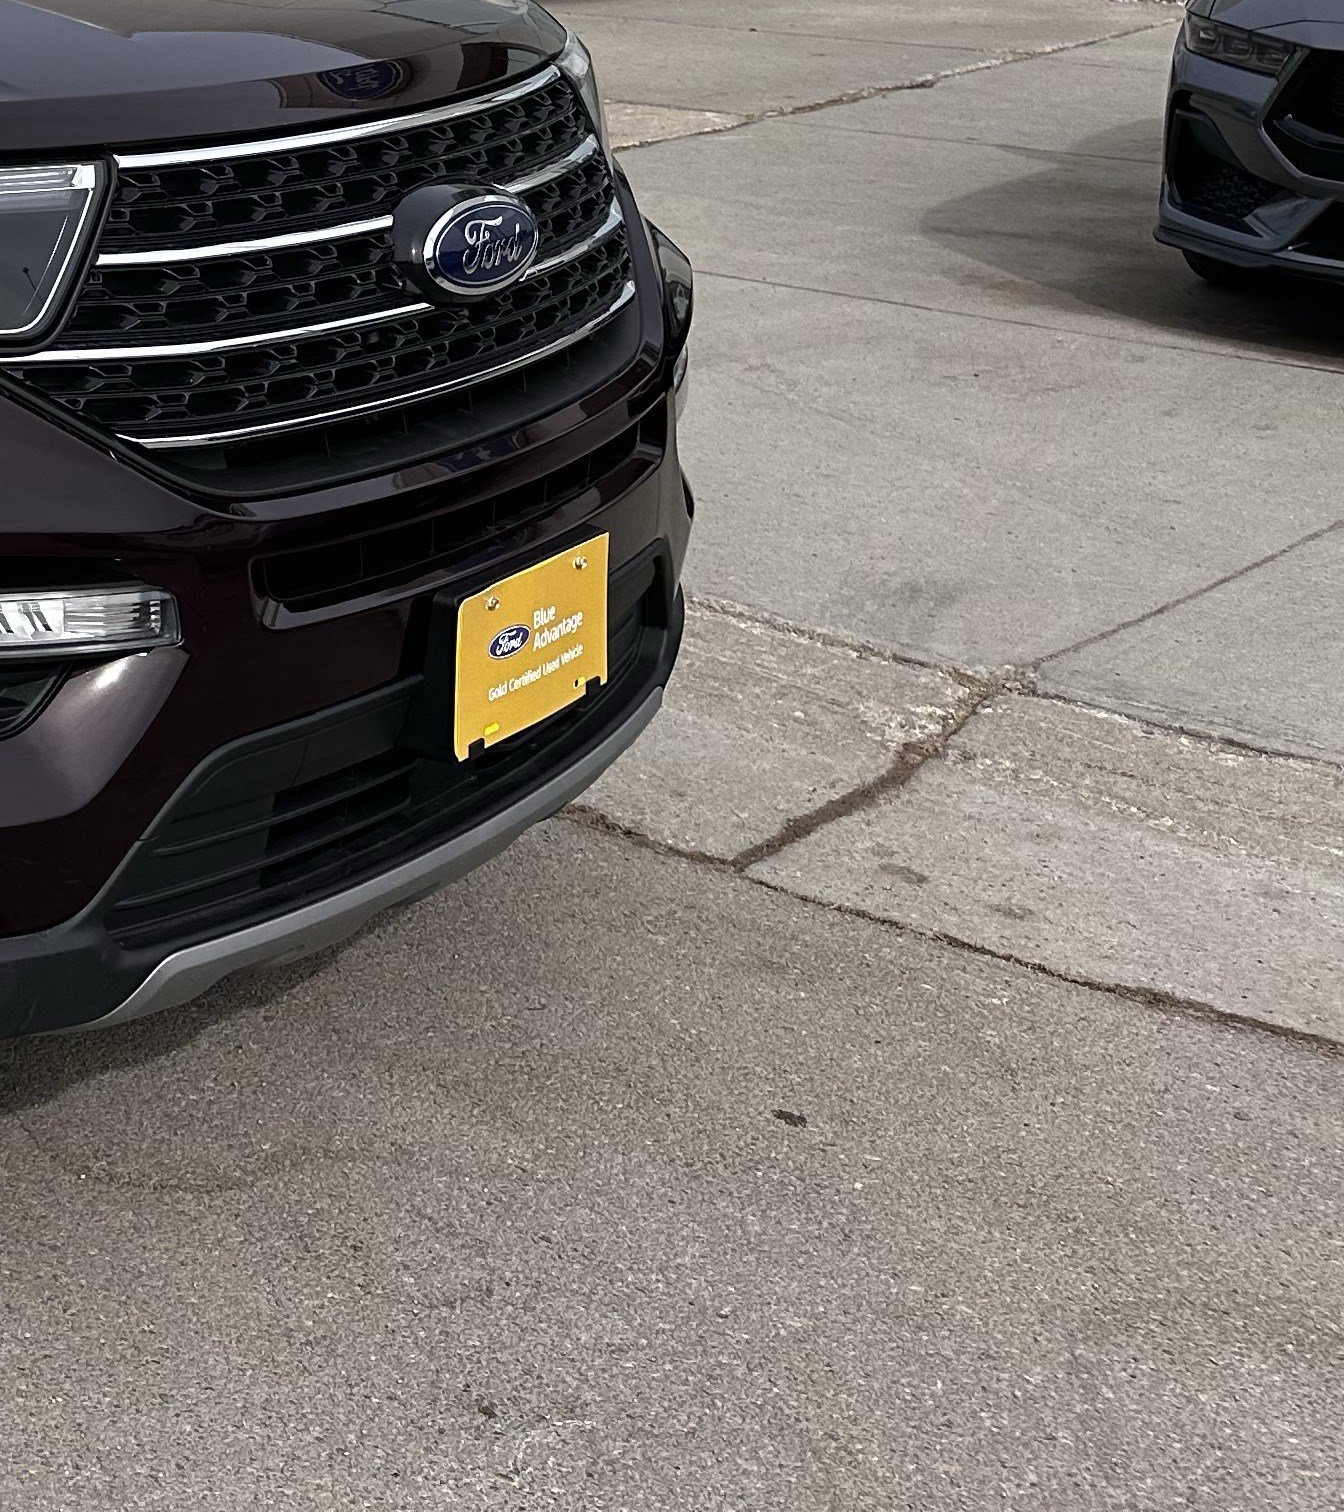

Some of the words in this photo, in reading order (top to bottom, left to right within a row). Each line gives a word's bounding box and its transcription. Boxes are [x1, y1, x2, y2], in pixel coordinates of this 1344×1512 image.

[463, 216, 523, 275] Ford
[532, 611, 584, 652] Advantage
[533, 605, 556, 630] Blue
[495, 630, 524, 656] Ford
[488, 681, 508, 701] Gold
[508, 665, 542, 692] Certified
[542, 655, 560, 675] Used
[560, 643, 584, 666] Vehicle
